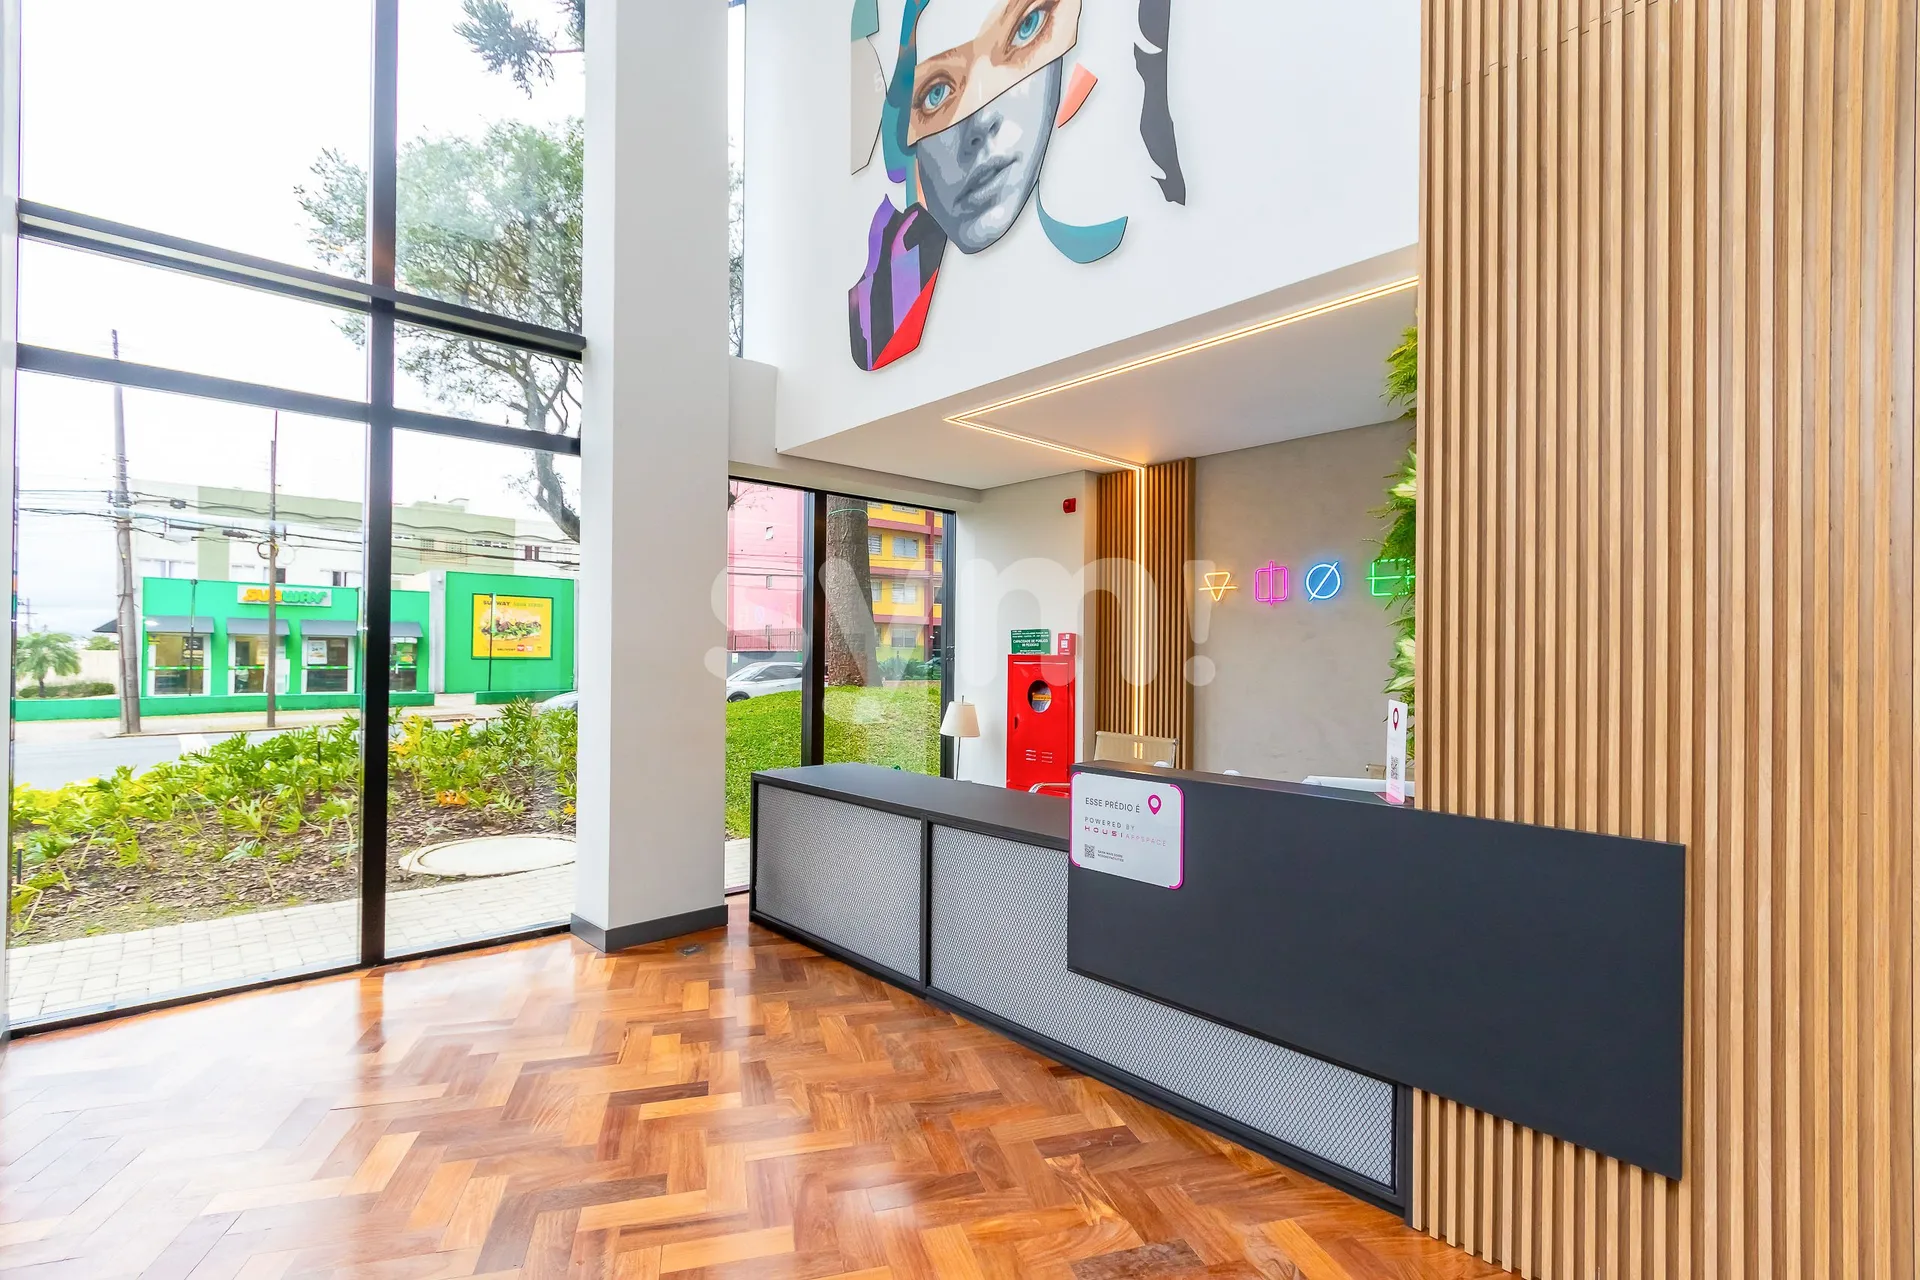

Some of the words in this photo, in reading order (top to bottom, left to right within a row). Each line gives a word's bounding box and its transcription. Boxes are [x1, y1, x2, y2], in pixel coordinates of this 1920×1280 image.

[243, 588, 327, 604] SUBWAY
[1085, 797, 1103, 807] ESSE
[1105, 800, 1134, 812] PRÉDIO
[1135, 804, 1141, 814] É
[1085, 816, 1122, 828] POWERED
[1085, 825, 1123, 837] HOUSI
